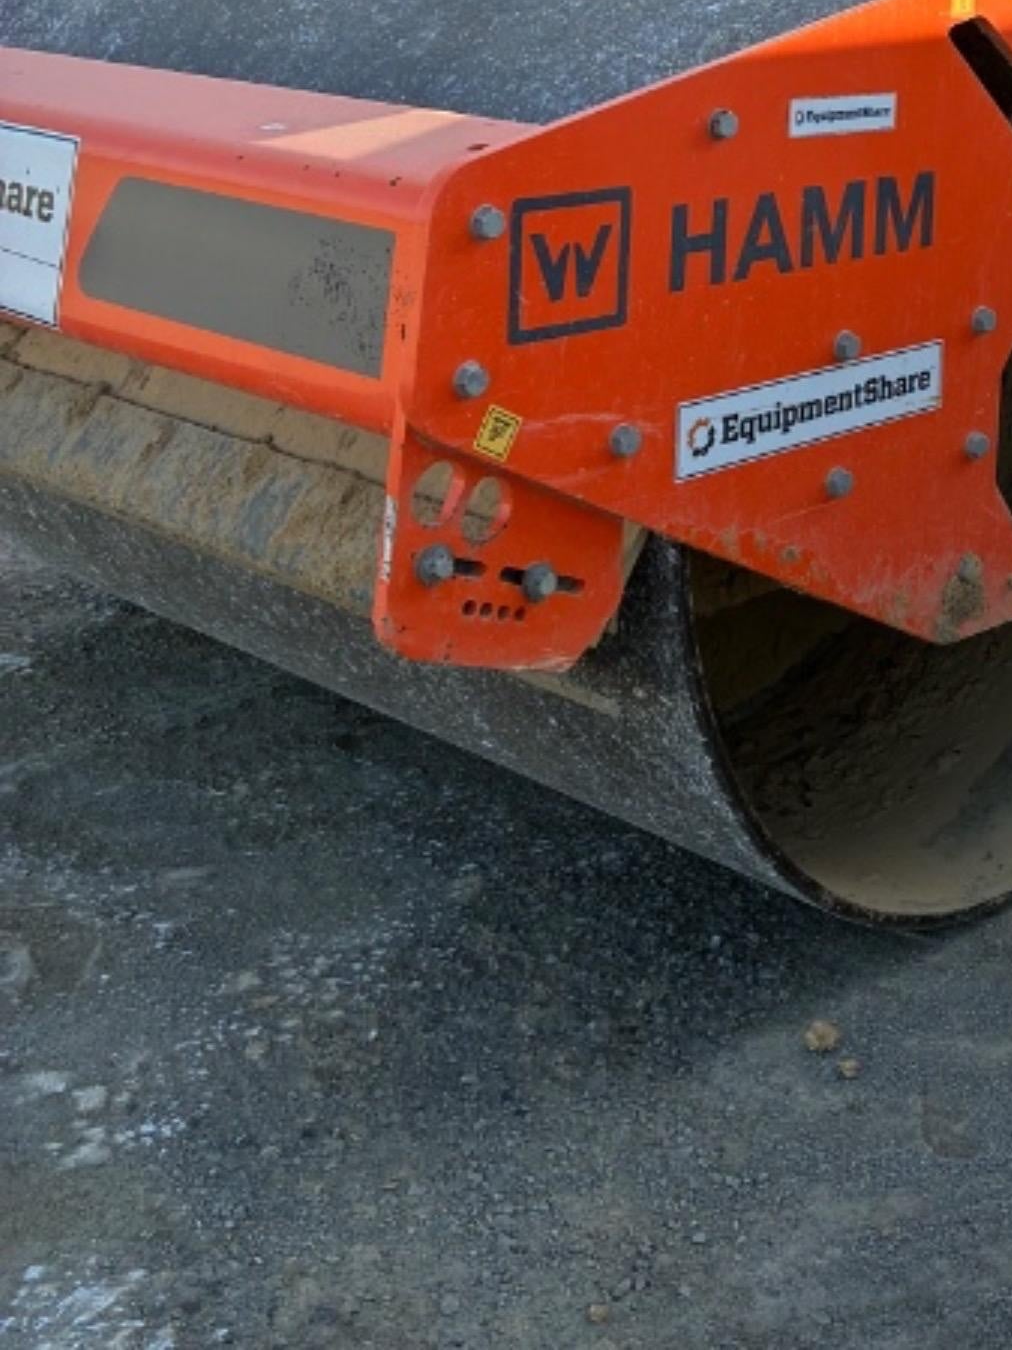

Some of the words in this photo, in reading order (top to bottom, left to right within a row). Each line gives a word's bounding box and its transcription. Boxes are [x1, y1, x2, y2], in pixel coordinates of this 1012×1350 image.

[0, 179, 55, 223] are
[668, 171, 935, 292] HAMM
[720, 369, 932, 444] EquipmentShare
